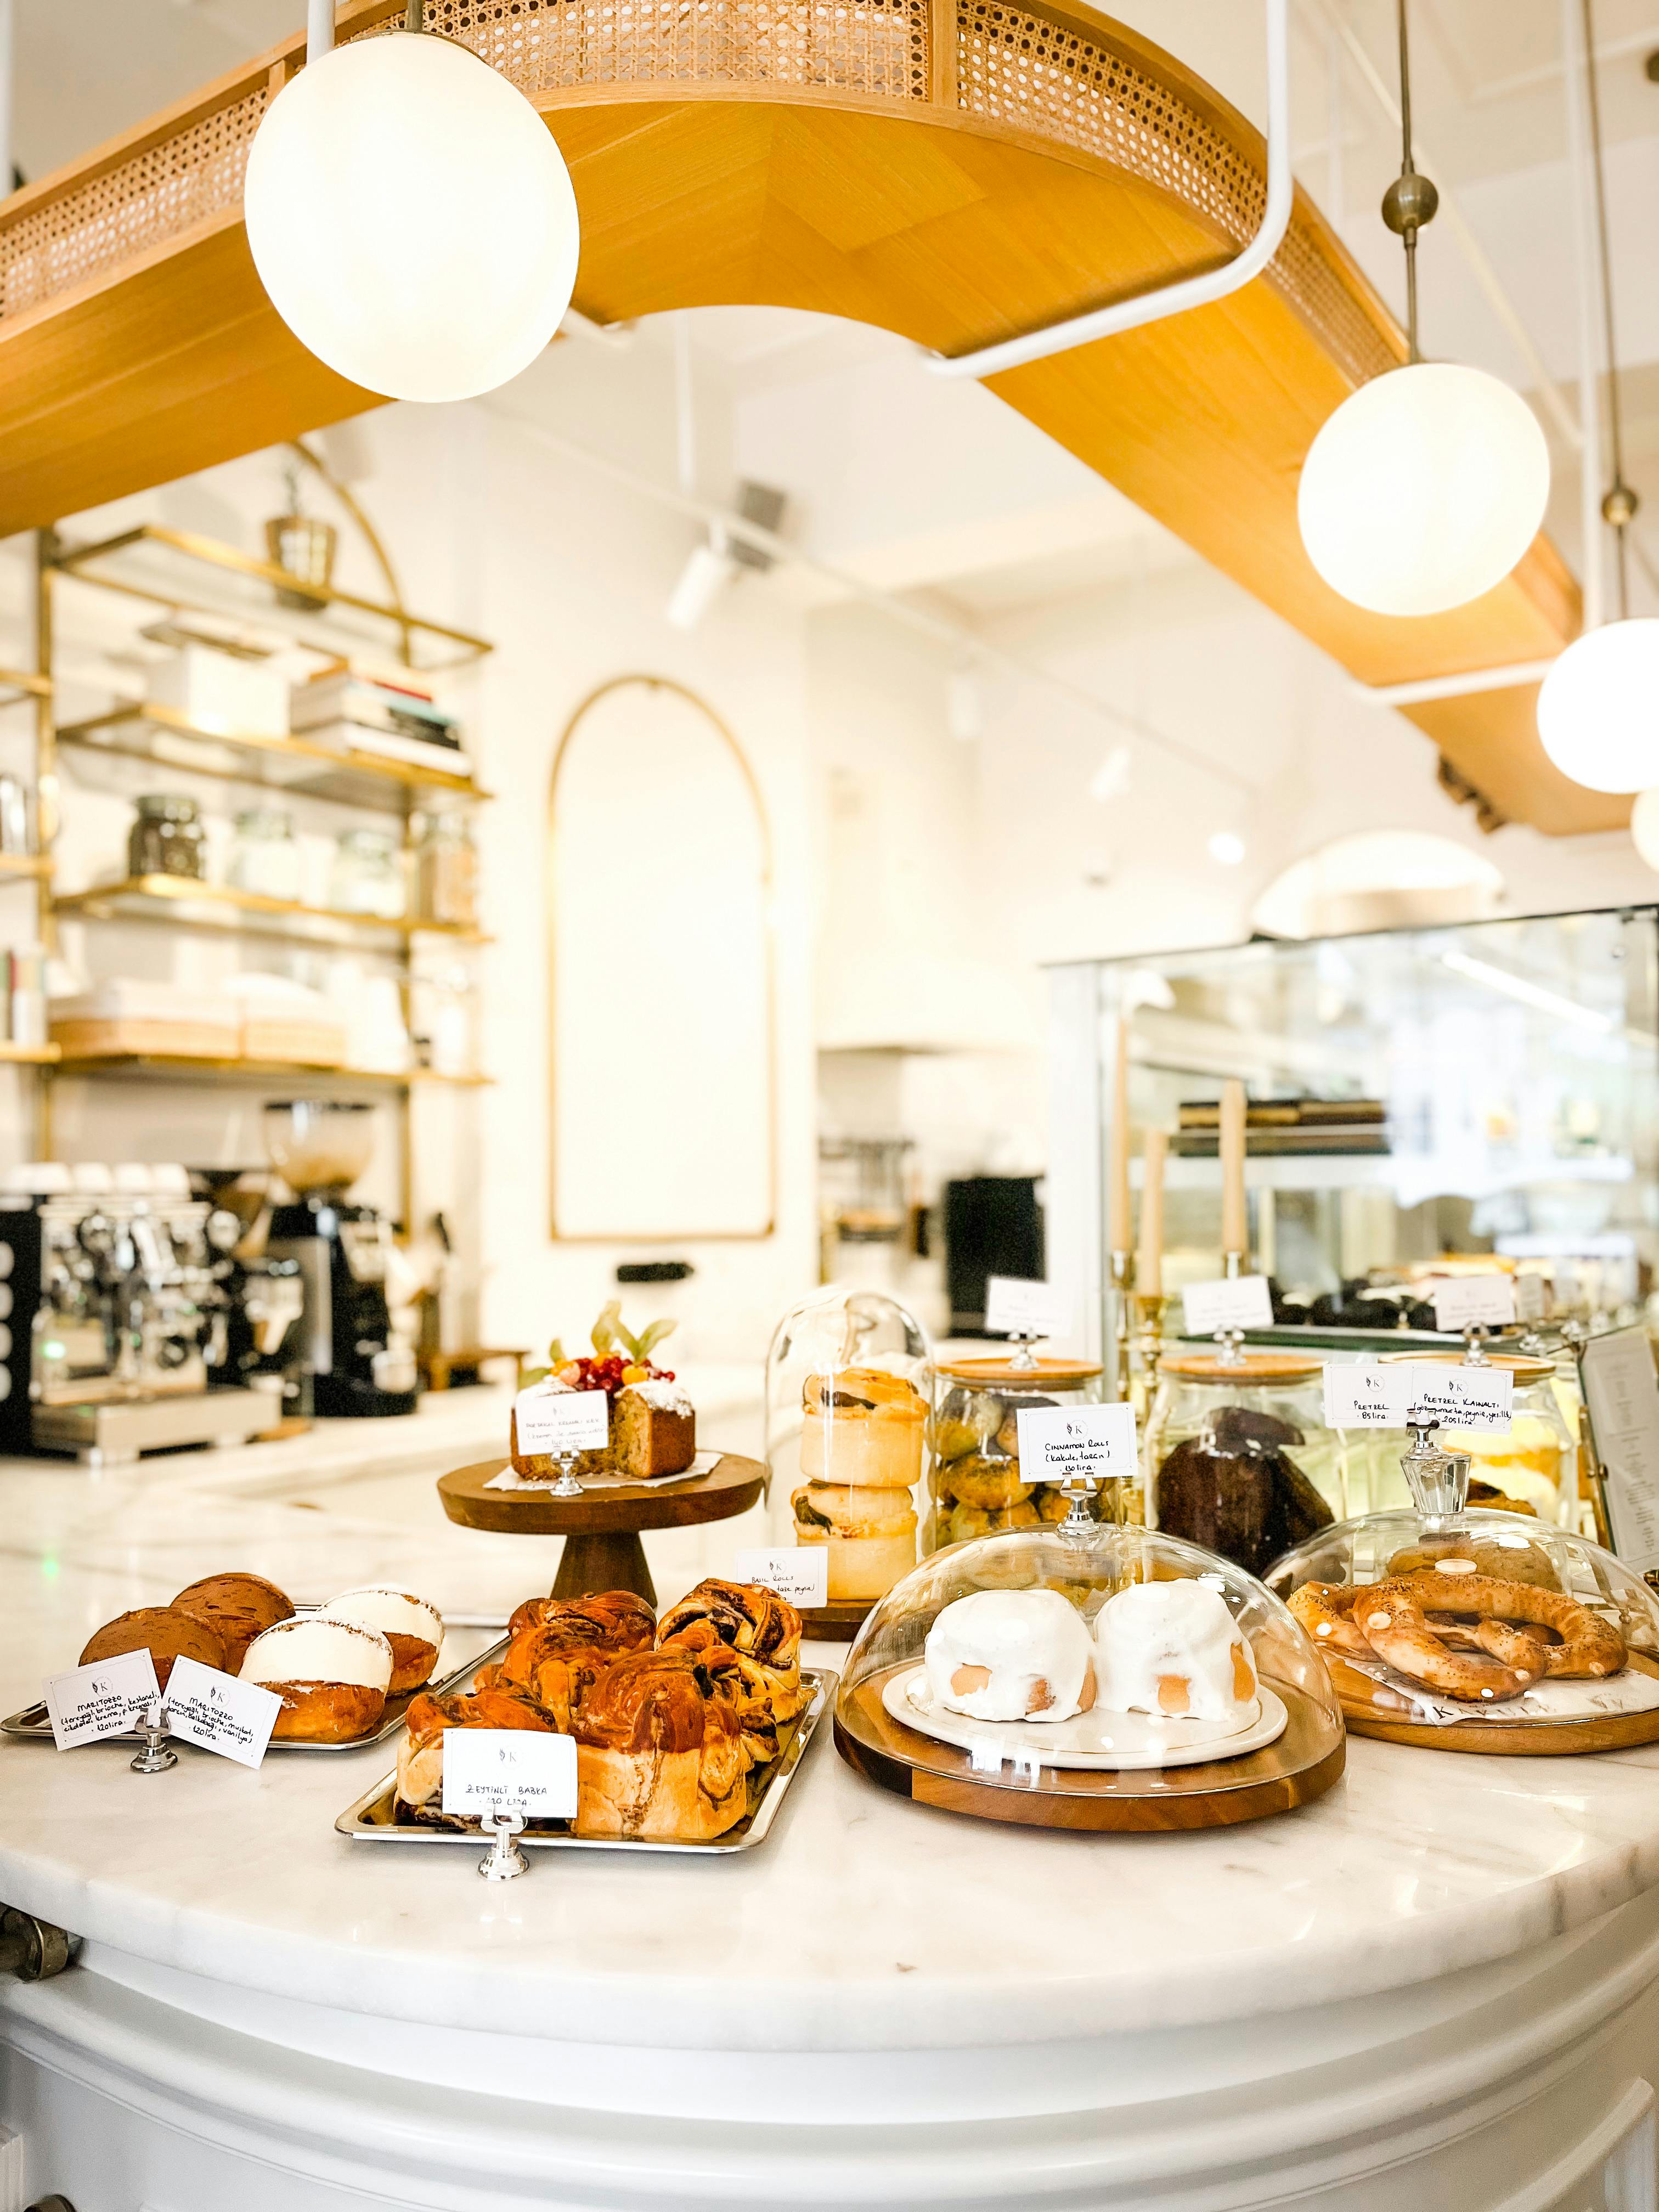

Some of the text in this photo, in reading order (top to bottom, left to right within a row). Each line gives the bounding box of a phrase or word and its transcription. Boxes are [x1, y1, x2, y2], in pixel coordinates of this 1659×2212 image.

[1076, 1425, 1082, 1434] K
[100, 1681, 109, 1692] K
[217, 1692, 225, 1703] K
